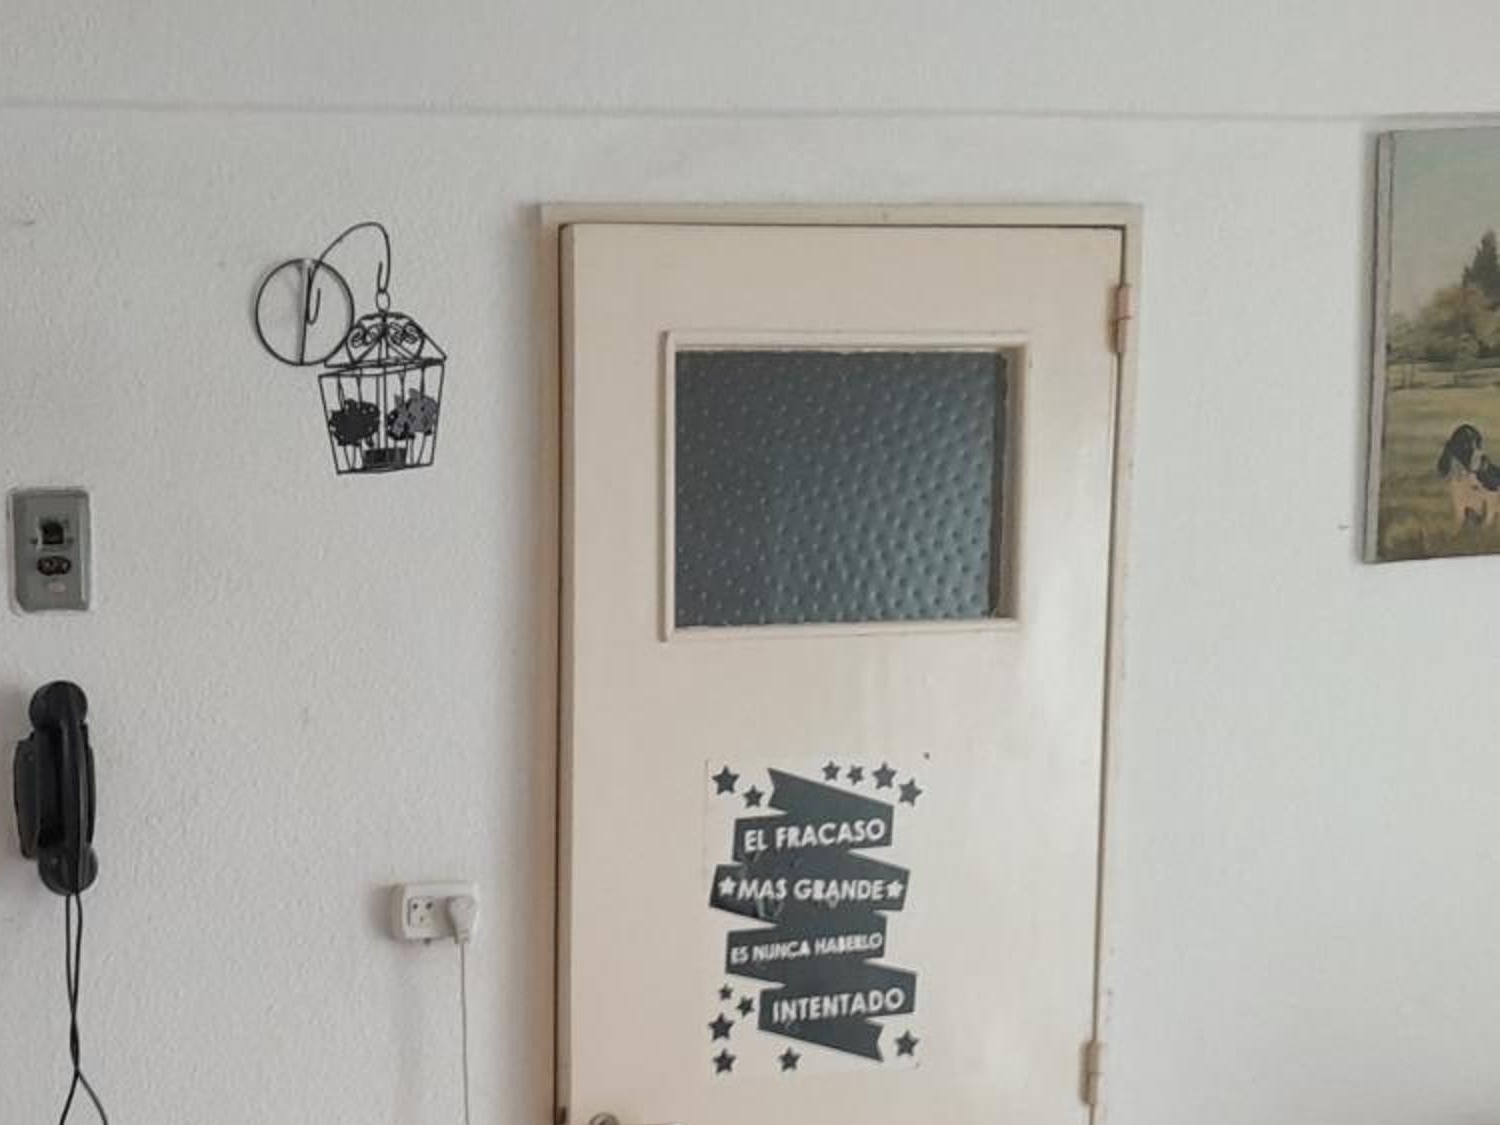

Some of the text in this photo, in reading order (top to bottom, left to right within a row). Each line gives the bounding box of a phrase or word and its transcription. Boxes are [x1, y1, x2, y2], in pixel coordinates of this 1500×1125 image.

[744, 818, 886, 852] EL FRACASO
[737, 878, 885, 900] MAS GRANDE
[730, 932, 883, 964] ES NUNCA HABERLO
[772, 987, 906, 1023] INTENTADO
